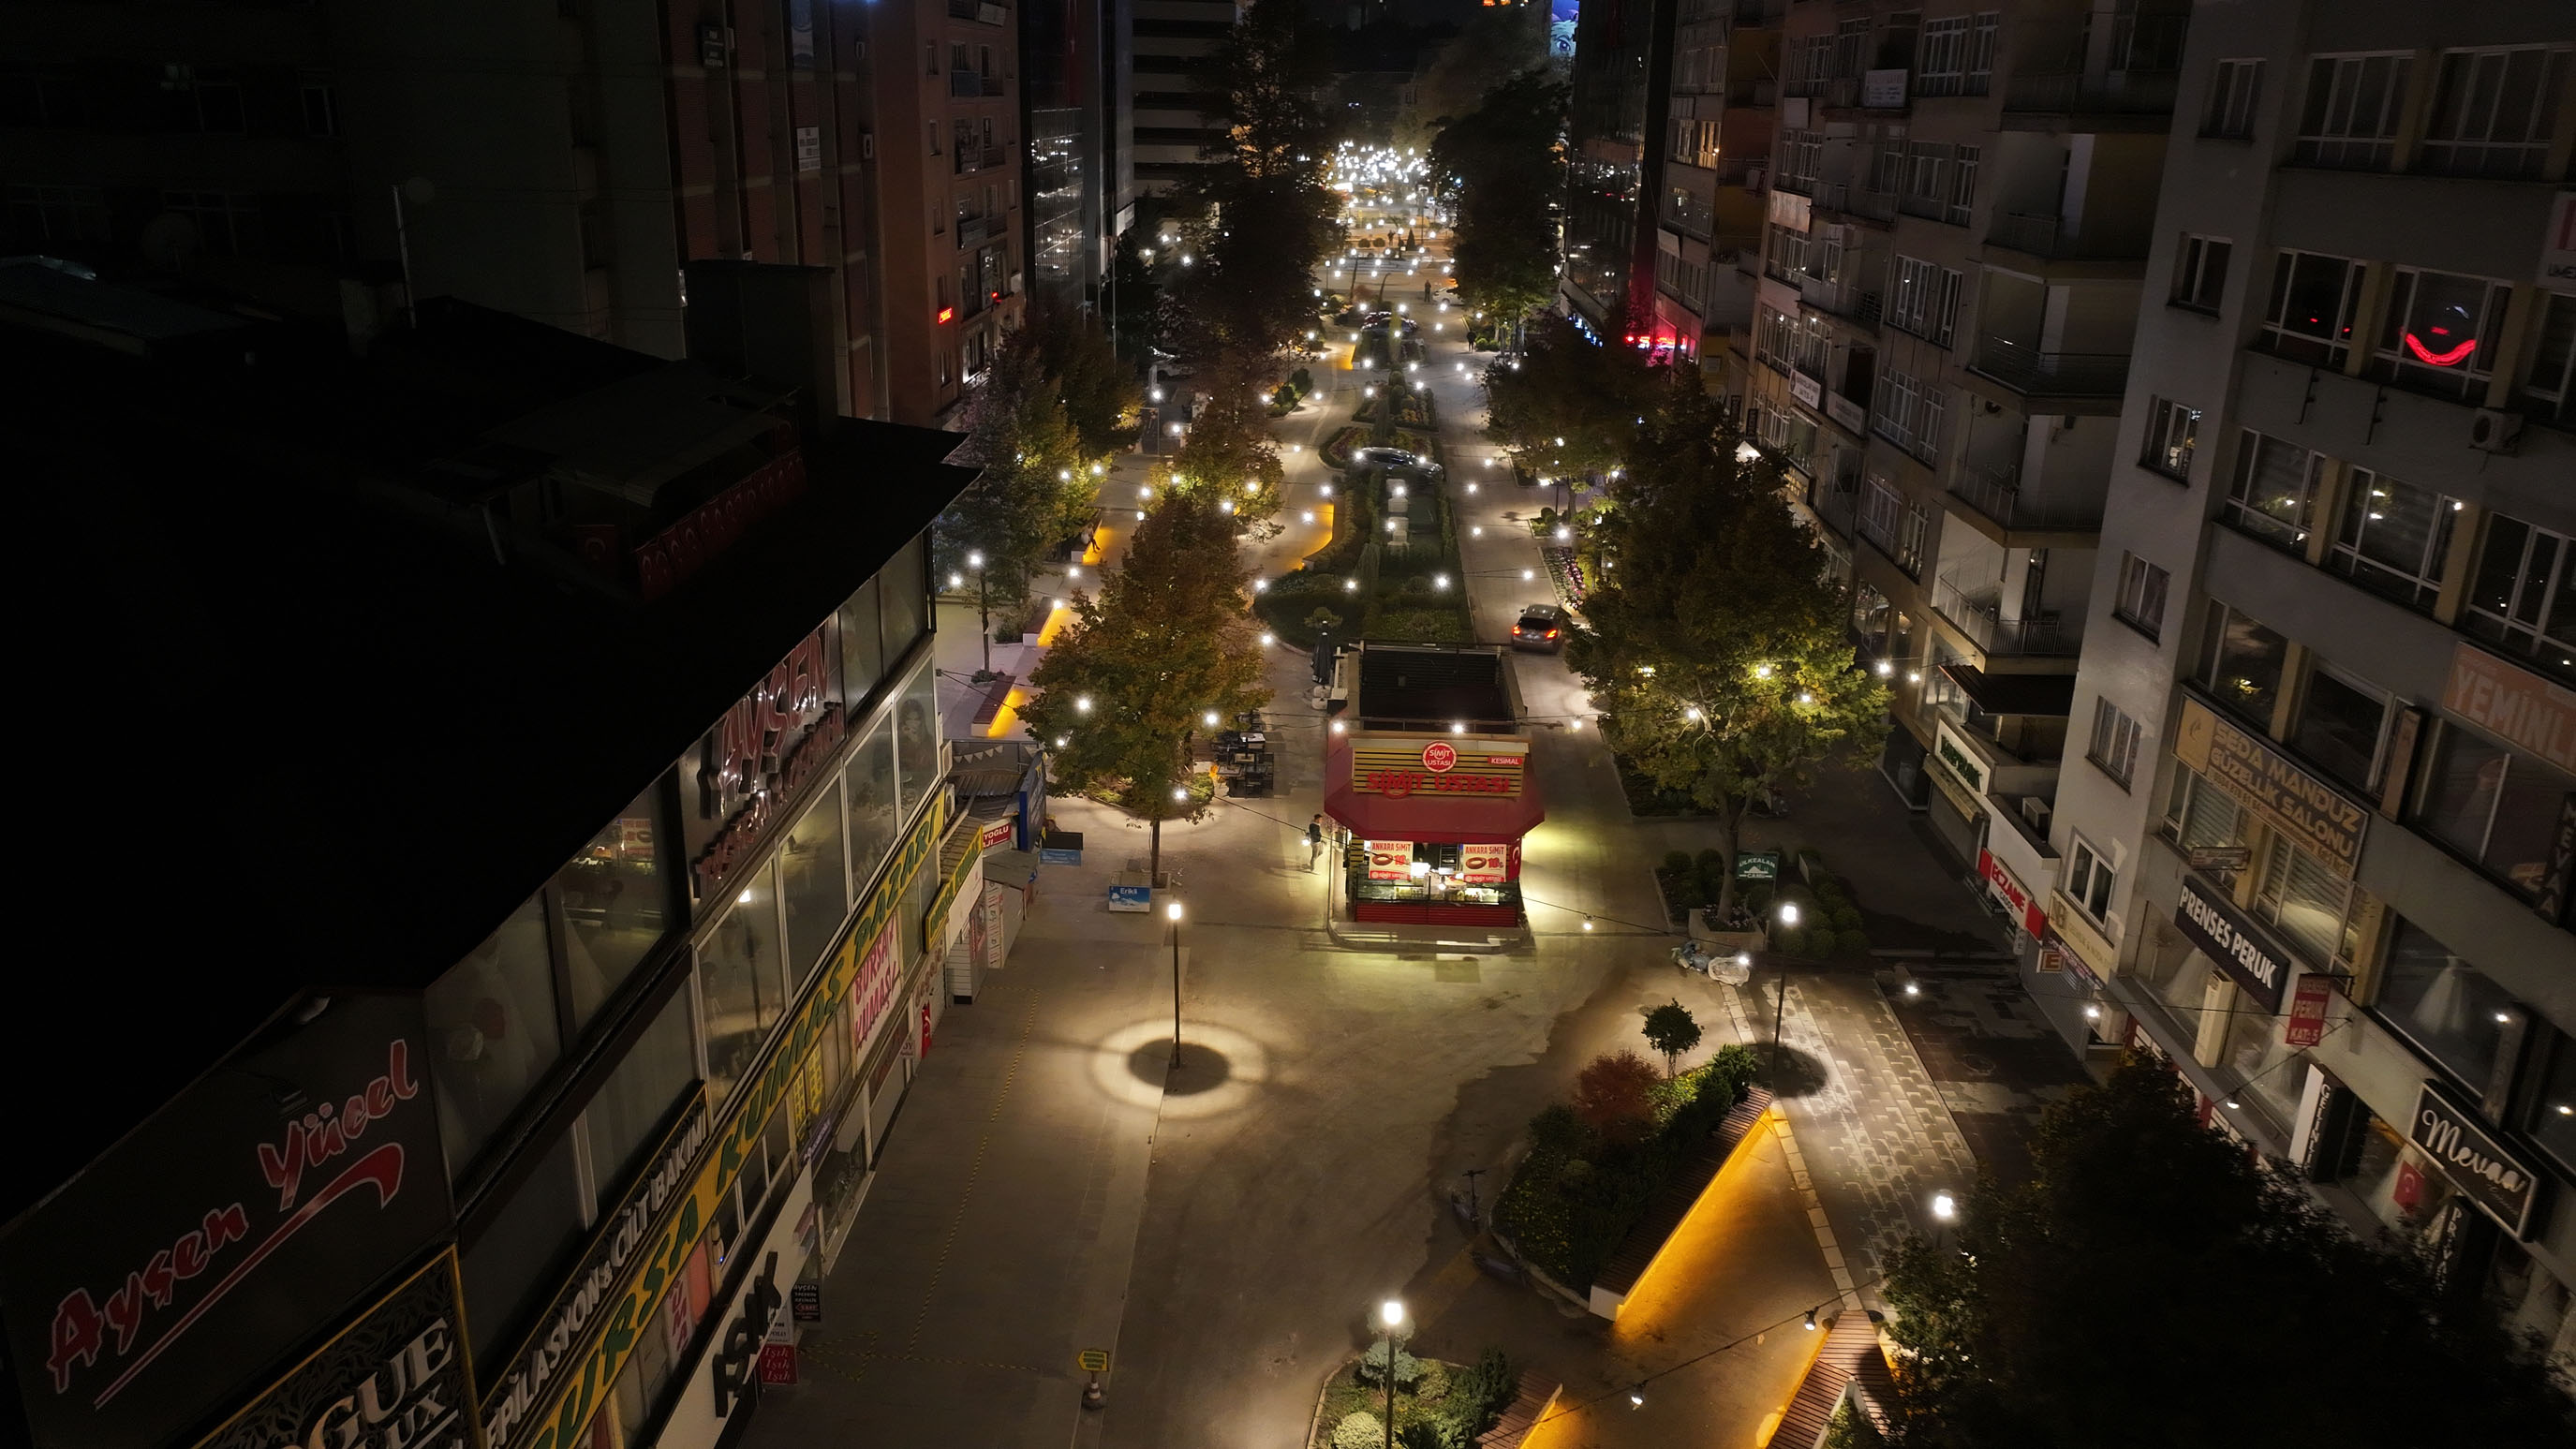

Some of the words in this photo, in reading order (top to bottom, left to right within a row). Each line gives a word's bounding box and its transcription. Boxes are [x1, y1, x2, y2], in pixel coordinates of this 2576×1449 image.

[1434, 775, 1510, 793] USTASI
[2210, 747, 2280, 807] GÜZELLİK
[2280, 797, 2354, 858] SALONU
[2214, 722, 2264, 772] SEDA
[2268, 757, 2361, 832] MANDUZ
[1371, 843, 1395, 851] ANKARA
[1465, 847, 1488, 855] ANKARA
[1991, 863, 2025, 913] ECZANE
[2179, 884, 2233, 949] PRENSES
[2230, 931, 2278, 990] PERUK
[530, 1193, 700, 1449] URSA
[716, 955, 843, 1197] KUMAŞ
[852, 802, 938, 968] PAZARI
[45, 1201, 249, 1395] Ayşen
[258, 1039, 419, 1212] Yücel
[611, 1199, 649, 1266] CİLT
[281, 1316, 453, 1449] GUE
